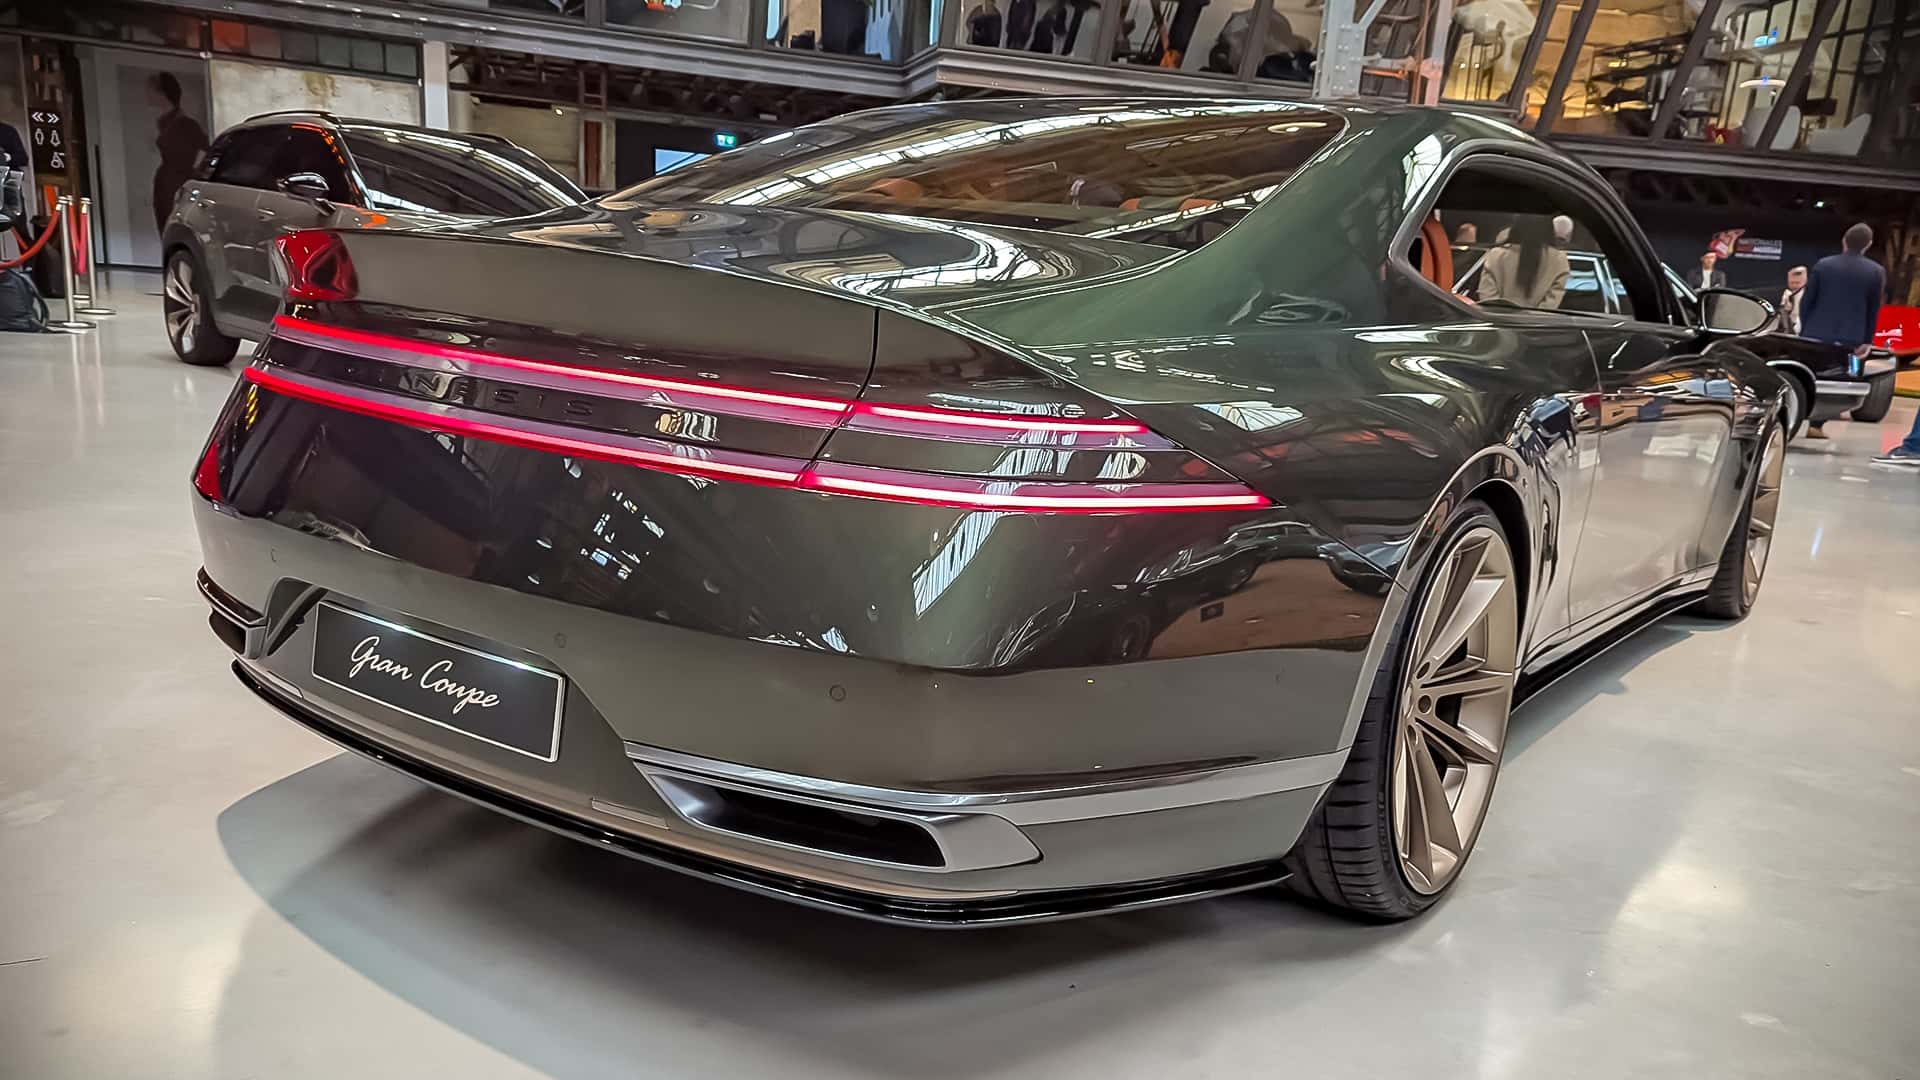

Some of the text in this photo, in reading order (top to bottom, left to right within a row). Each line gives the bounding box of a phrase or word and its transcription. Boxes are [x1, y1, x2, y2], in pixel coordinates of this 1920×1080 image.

[346, 364, 593, 417] NESIS
[350, 636, 500, 714] Gran Coupe
